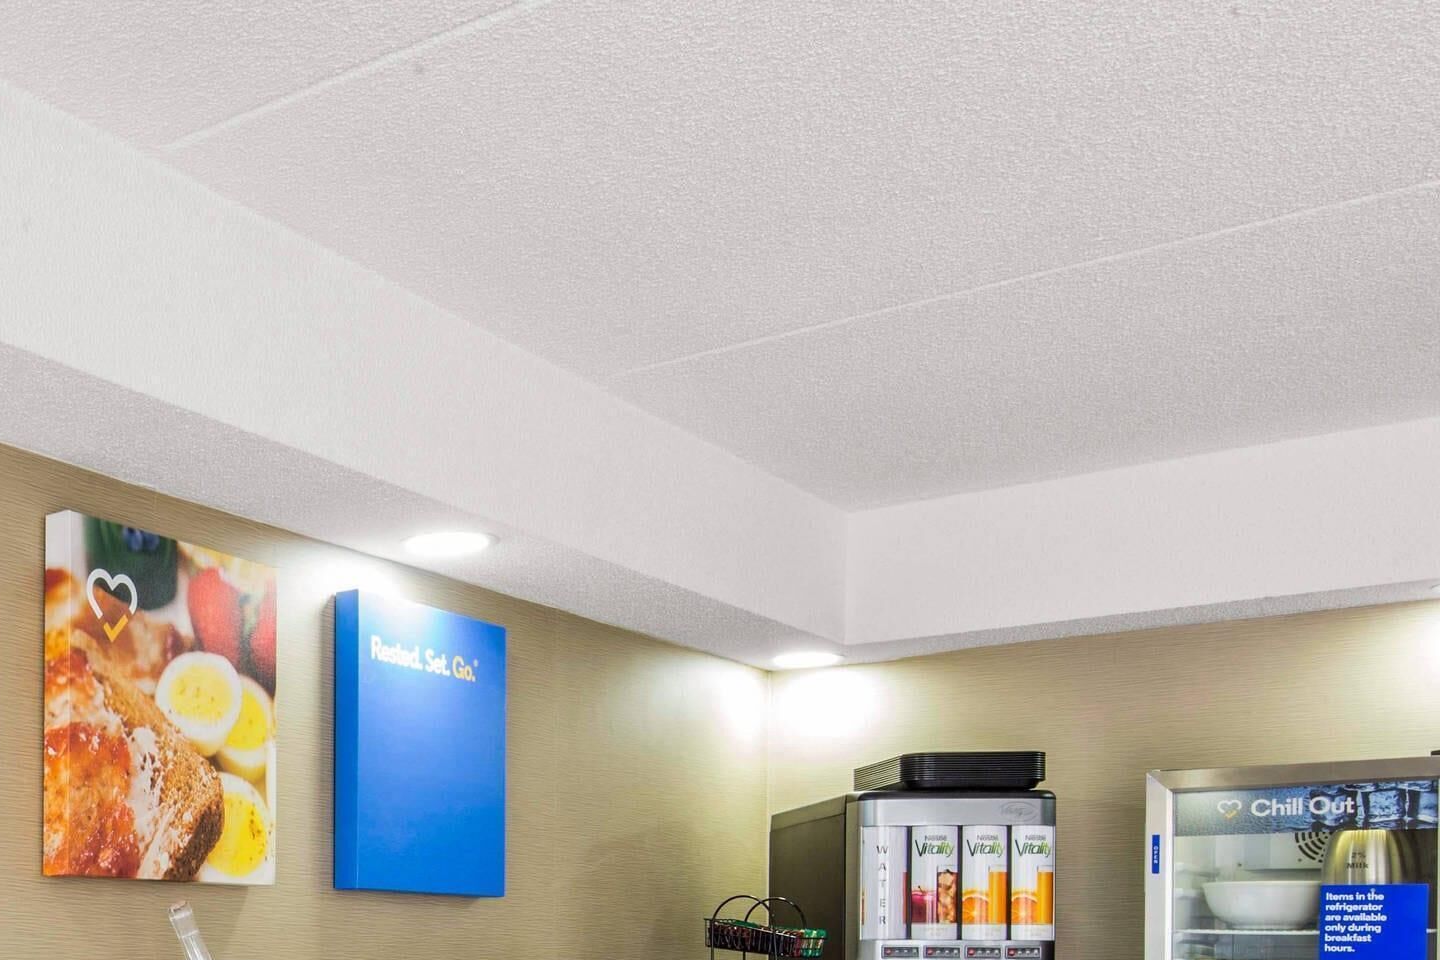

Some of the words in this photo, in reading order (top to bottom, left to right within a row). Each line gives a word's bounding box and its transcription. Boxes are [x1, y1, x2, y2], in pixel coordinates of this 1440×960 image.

[370, 634, 423, 671] Rested.
[424, 648, 451, 677] Set.
[1250, 797, 1303, 817] Chill
[1309, 796, 1356, 815] Out
[914, 839, 955, 858] Vitality
[966, 839, 1005, 858] Vitality
[1014, 839, 1052, 858] Vitality
[875, 845, 889, 925] WATER
[1325, 892, 1354, 901] Items
[1355, 892, 1365, 900] in
[1367, 891, 1385, 901] the
[1325, 902, 1383, 913] refrigerator
[1342, 913, 1387, 922] available
[1324, 923, 1346, 933] only
[1347, 923, 1382, 933] during
[1324, 933, 1372, 942] breakfast
[1324, 944, 1355, 952] hours.
